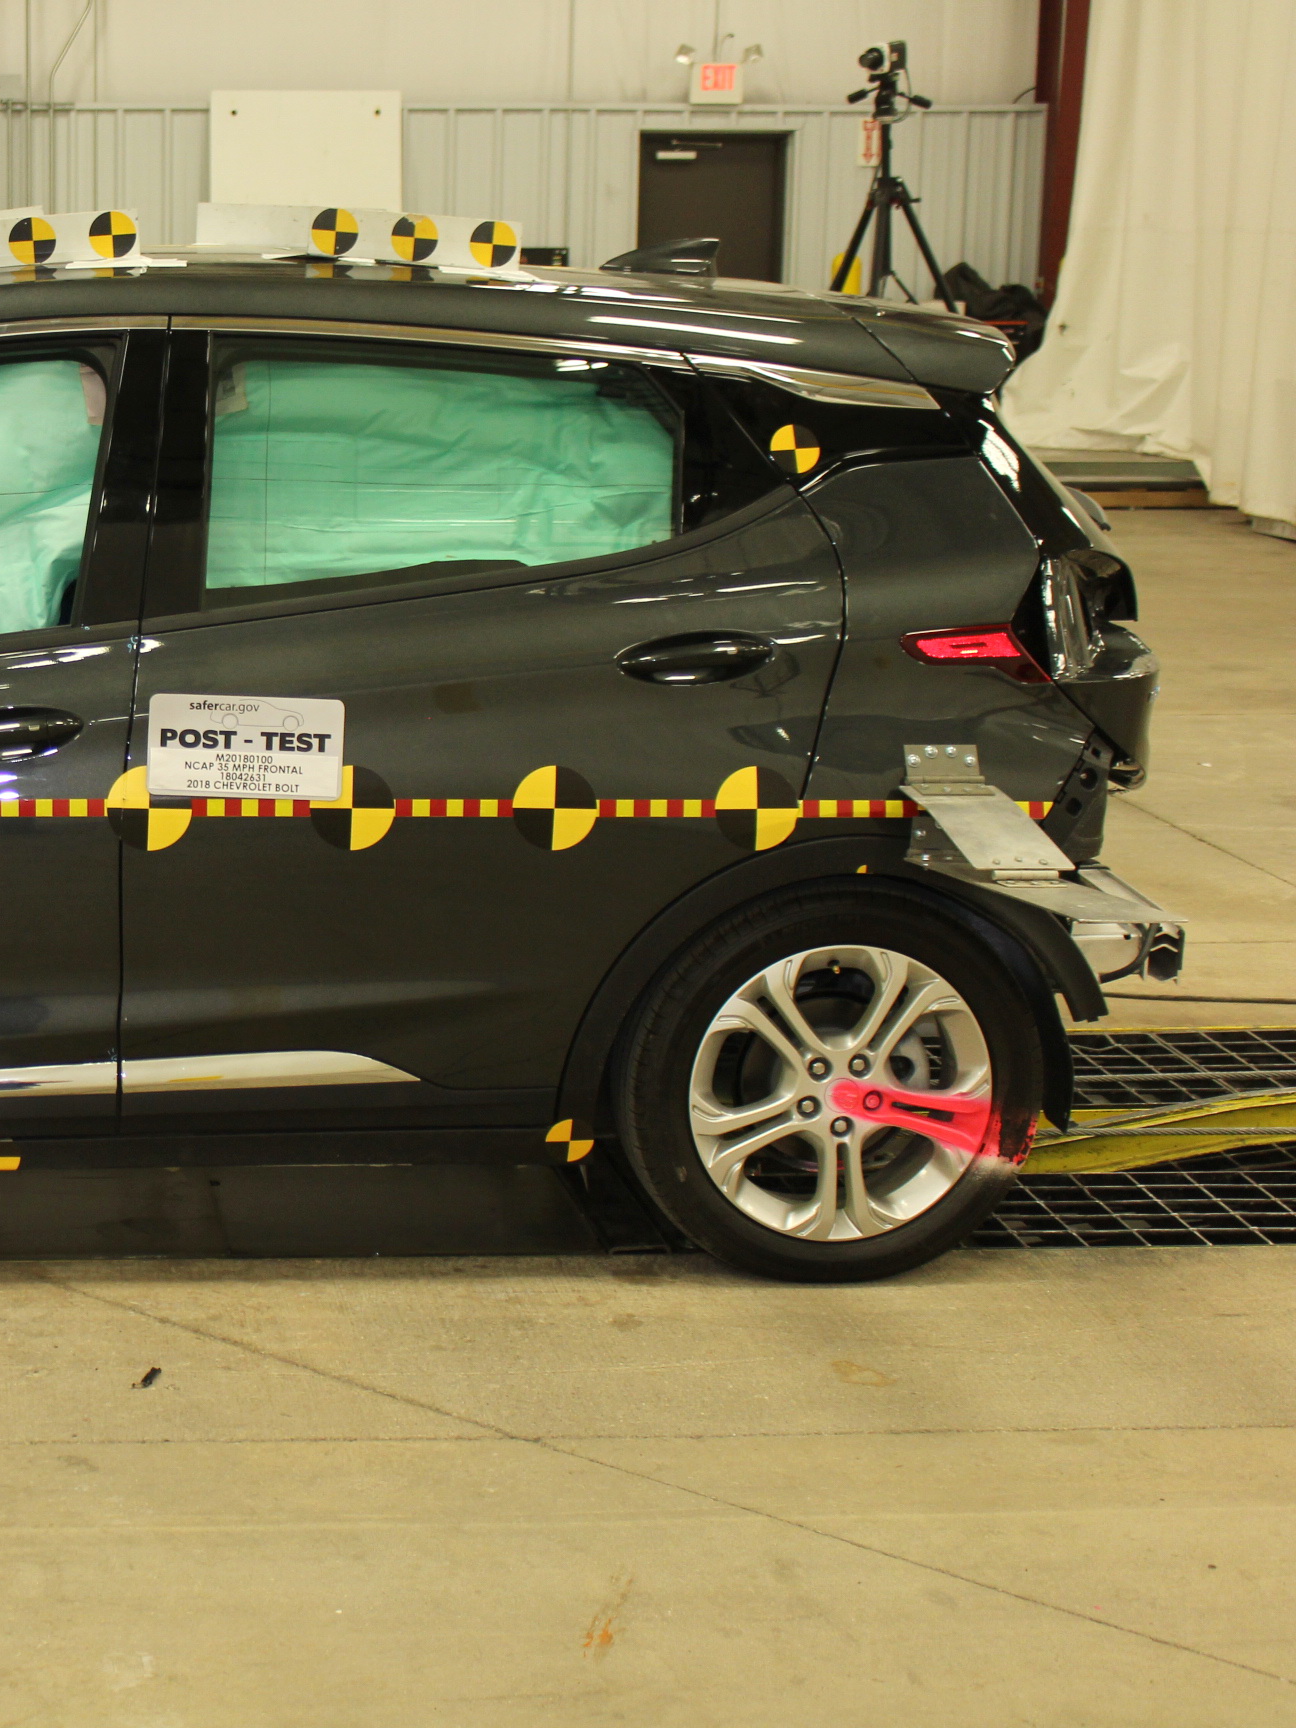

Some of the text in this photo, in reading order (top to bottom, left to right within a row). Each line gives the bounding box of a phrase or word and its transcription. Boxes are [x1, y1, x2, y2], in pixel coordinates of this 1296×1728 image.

[701, 64, 736, 91] EXIT
[189, 700, 260, 714] safercar.gov
[160, 728, 238, 750] POST
[260, 731, 332, 753] TEST
[215, 753, 273, 765] M20180100
[184, 761, 303, 775] NCAP 35 MPH FRONTAL
[220, 771, 266, 783] 18042631
[186, 779, 300, 793] 2018 CHEVROLET BOLT
